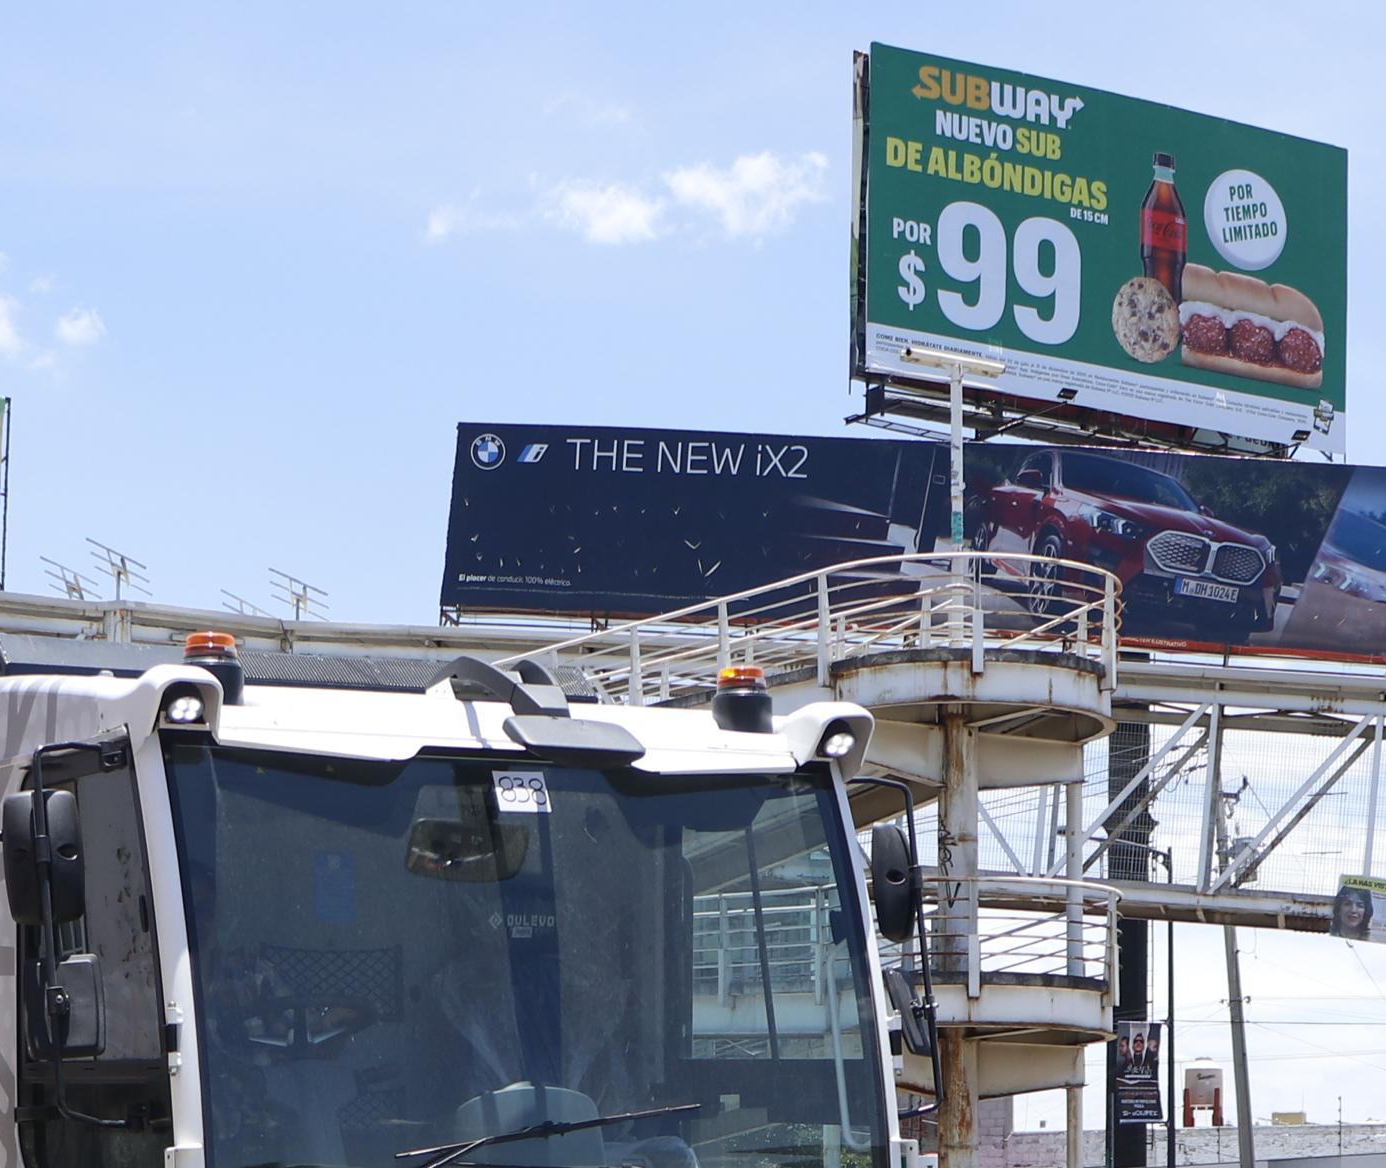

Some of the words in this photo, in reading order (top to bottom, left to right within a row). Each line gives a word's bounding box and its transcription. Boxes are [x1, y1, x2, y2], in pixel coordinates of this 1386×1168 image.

[912, 66, 1085, 129] SUBWAY
[935, 110, 1013, 151] NUEVO
[1015, 128, 1062, 160] SUB
[886, 136, 923, 171] DE
[927, 152, 1109, 211] ALBÓNDIGAS
[1229, 183, 1254, 202] POR
[1070, 207, 1082, 219] DE
[1083, 209, 1093, 221] 15
[1095, 212, 1109, 226] CM
[1223, 203, 1268, 221] TIEMPO
[892, 217, 932, 245] POR
[1222, 221, 1278, 244] LIMITADO
[566, 438, 644, 472] THE
[656, 442, 745, 476] NEW
[755, 444, 809, 479] iX2
[458, 573, 466, 581] El
[466, 574, 487, 583] placer
[525, 576, 544, 585] 100%
[499, 776, 547, 805] 838
